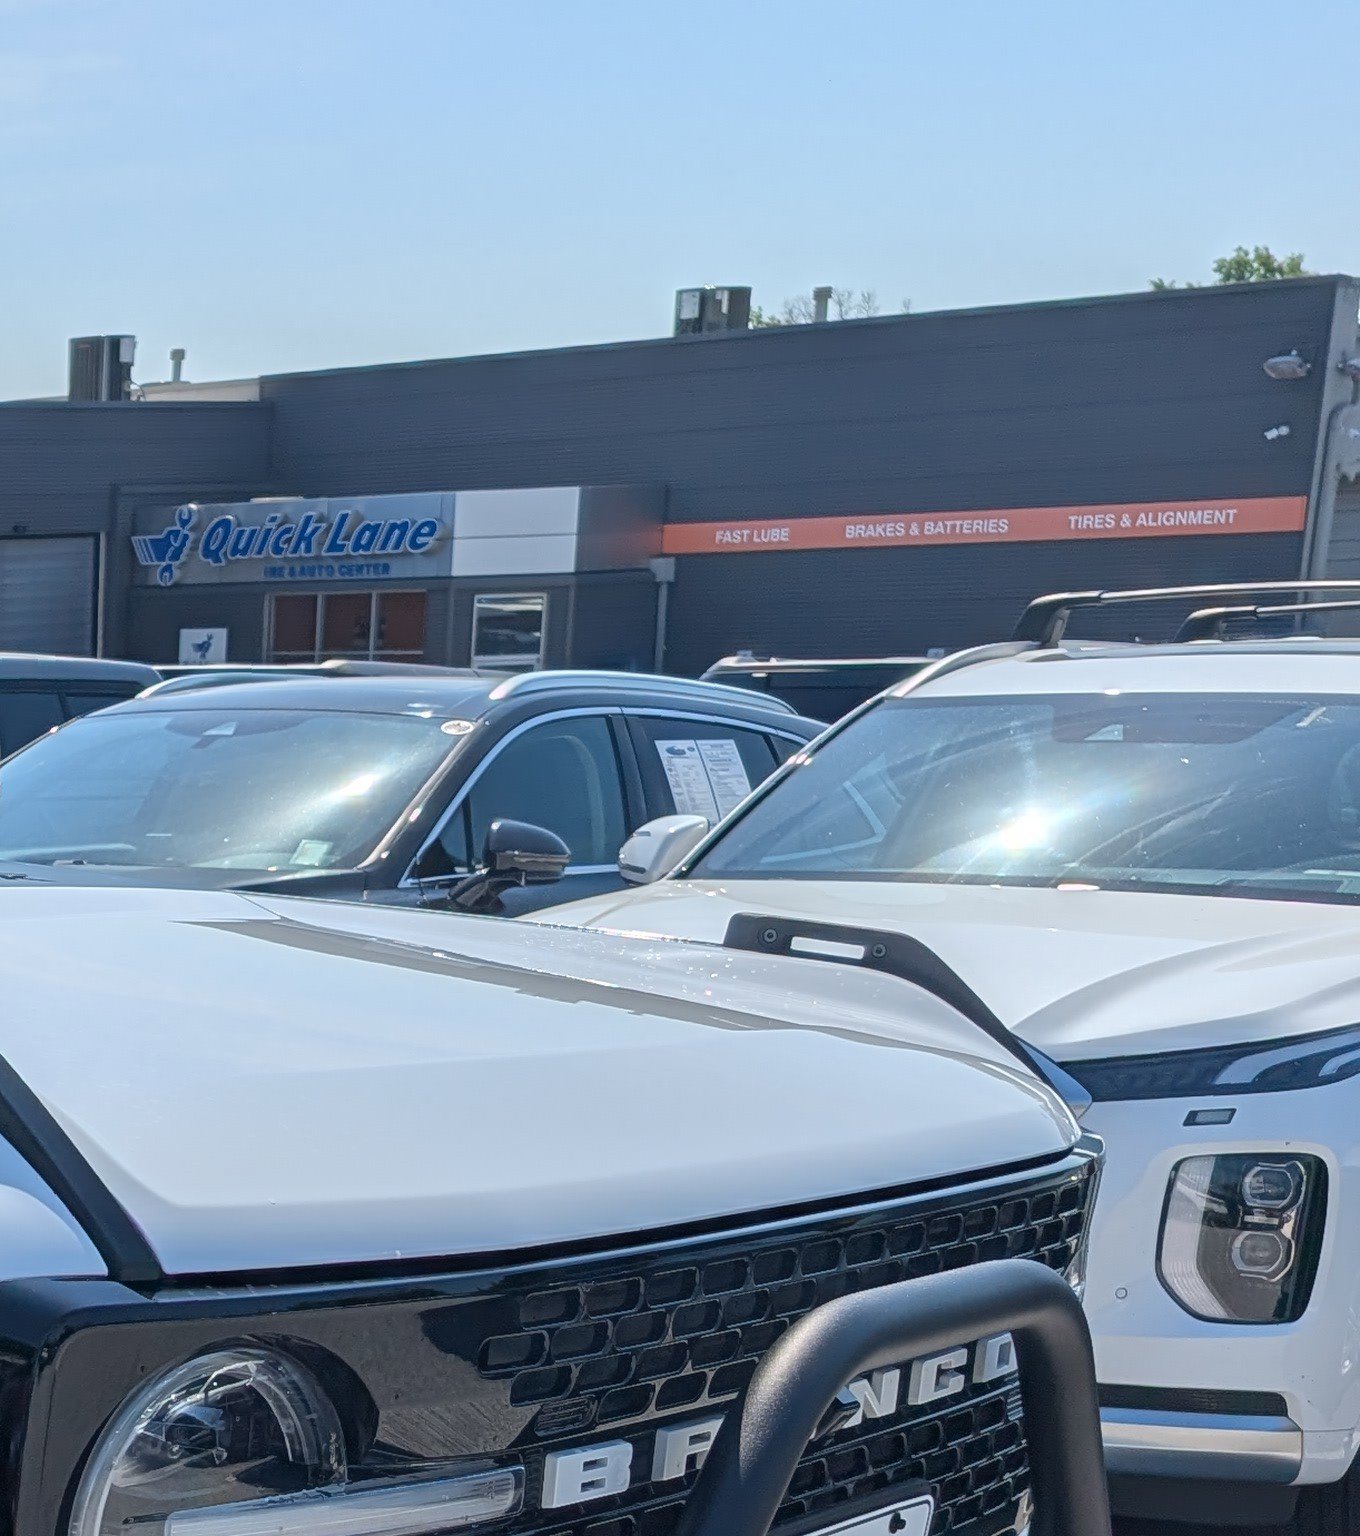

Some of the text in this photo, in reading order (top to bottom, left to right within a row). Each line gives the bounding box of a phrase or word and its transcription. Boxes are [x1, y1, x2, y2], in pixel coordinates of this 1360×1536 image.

[845, 518, 1009, 539] BRAKES & BATTERIES
[1068, 508, 1238, 531] TIRES & ALIGNMENT
[200, 510, 439, 566] Quick Lane
[715, 528, 790, 544] FAST LUBE
[299, 564, 334, 578] AUTO
[338, 562, 391, 577] CENTER
